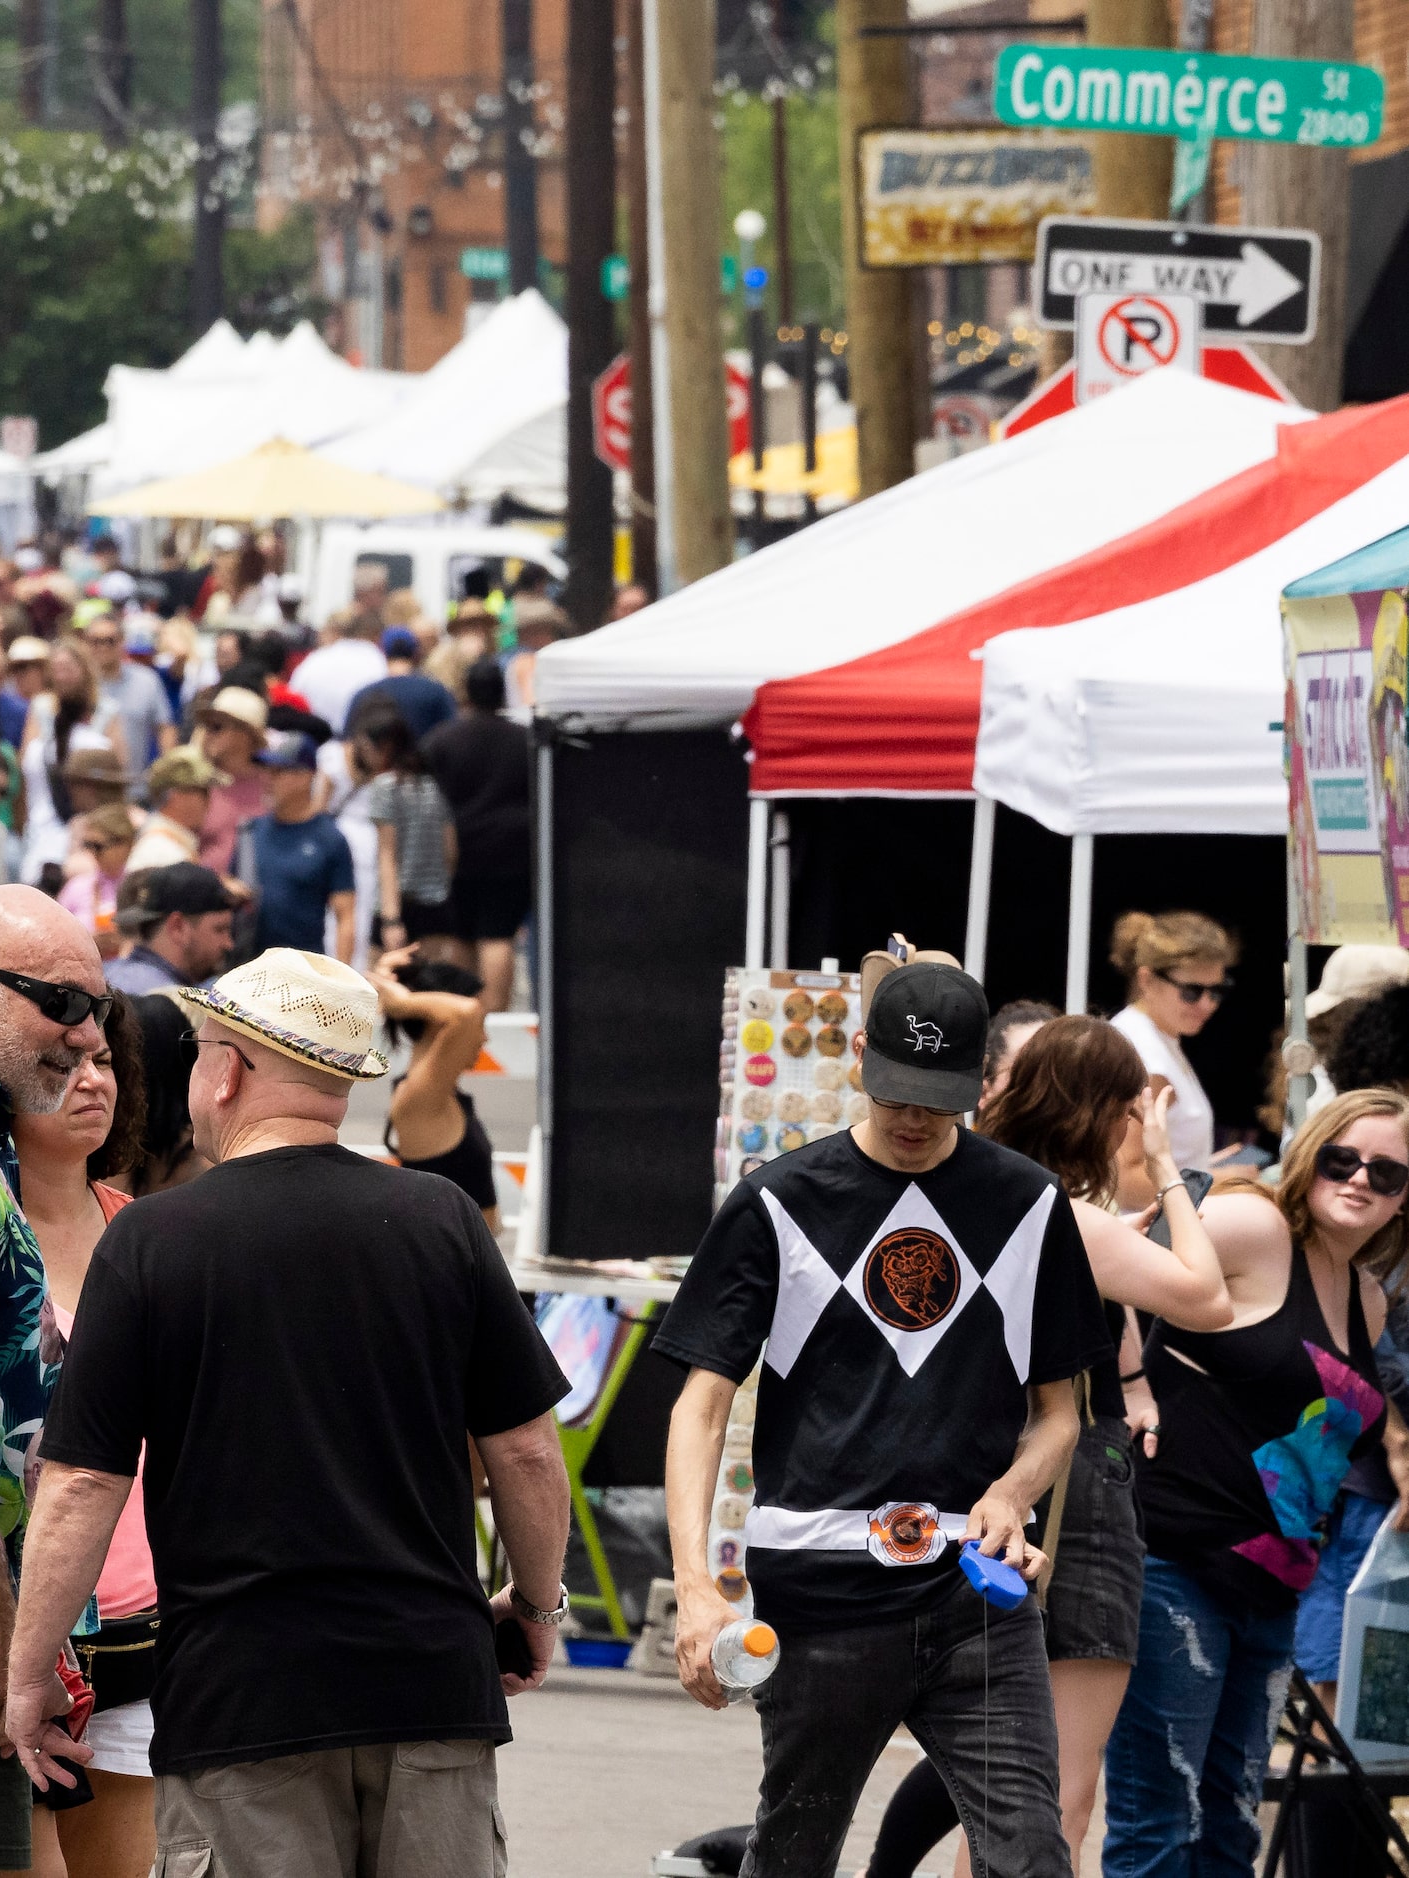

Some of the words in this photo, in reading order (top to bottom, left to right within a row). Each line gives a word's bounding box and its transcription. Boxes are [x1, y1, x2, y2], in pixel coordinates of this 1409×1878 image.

[1010, 53, 1287, 136] Commerce
[1322, 68, 1350, 102] St
[1297, 106, 1371, 147] 2800
[1152, 263, 1237, 296] WAY
